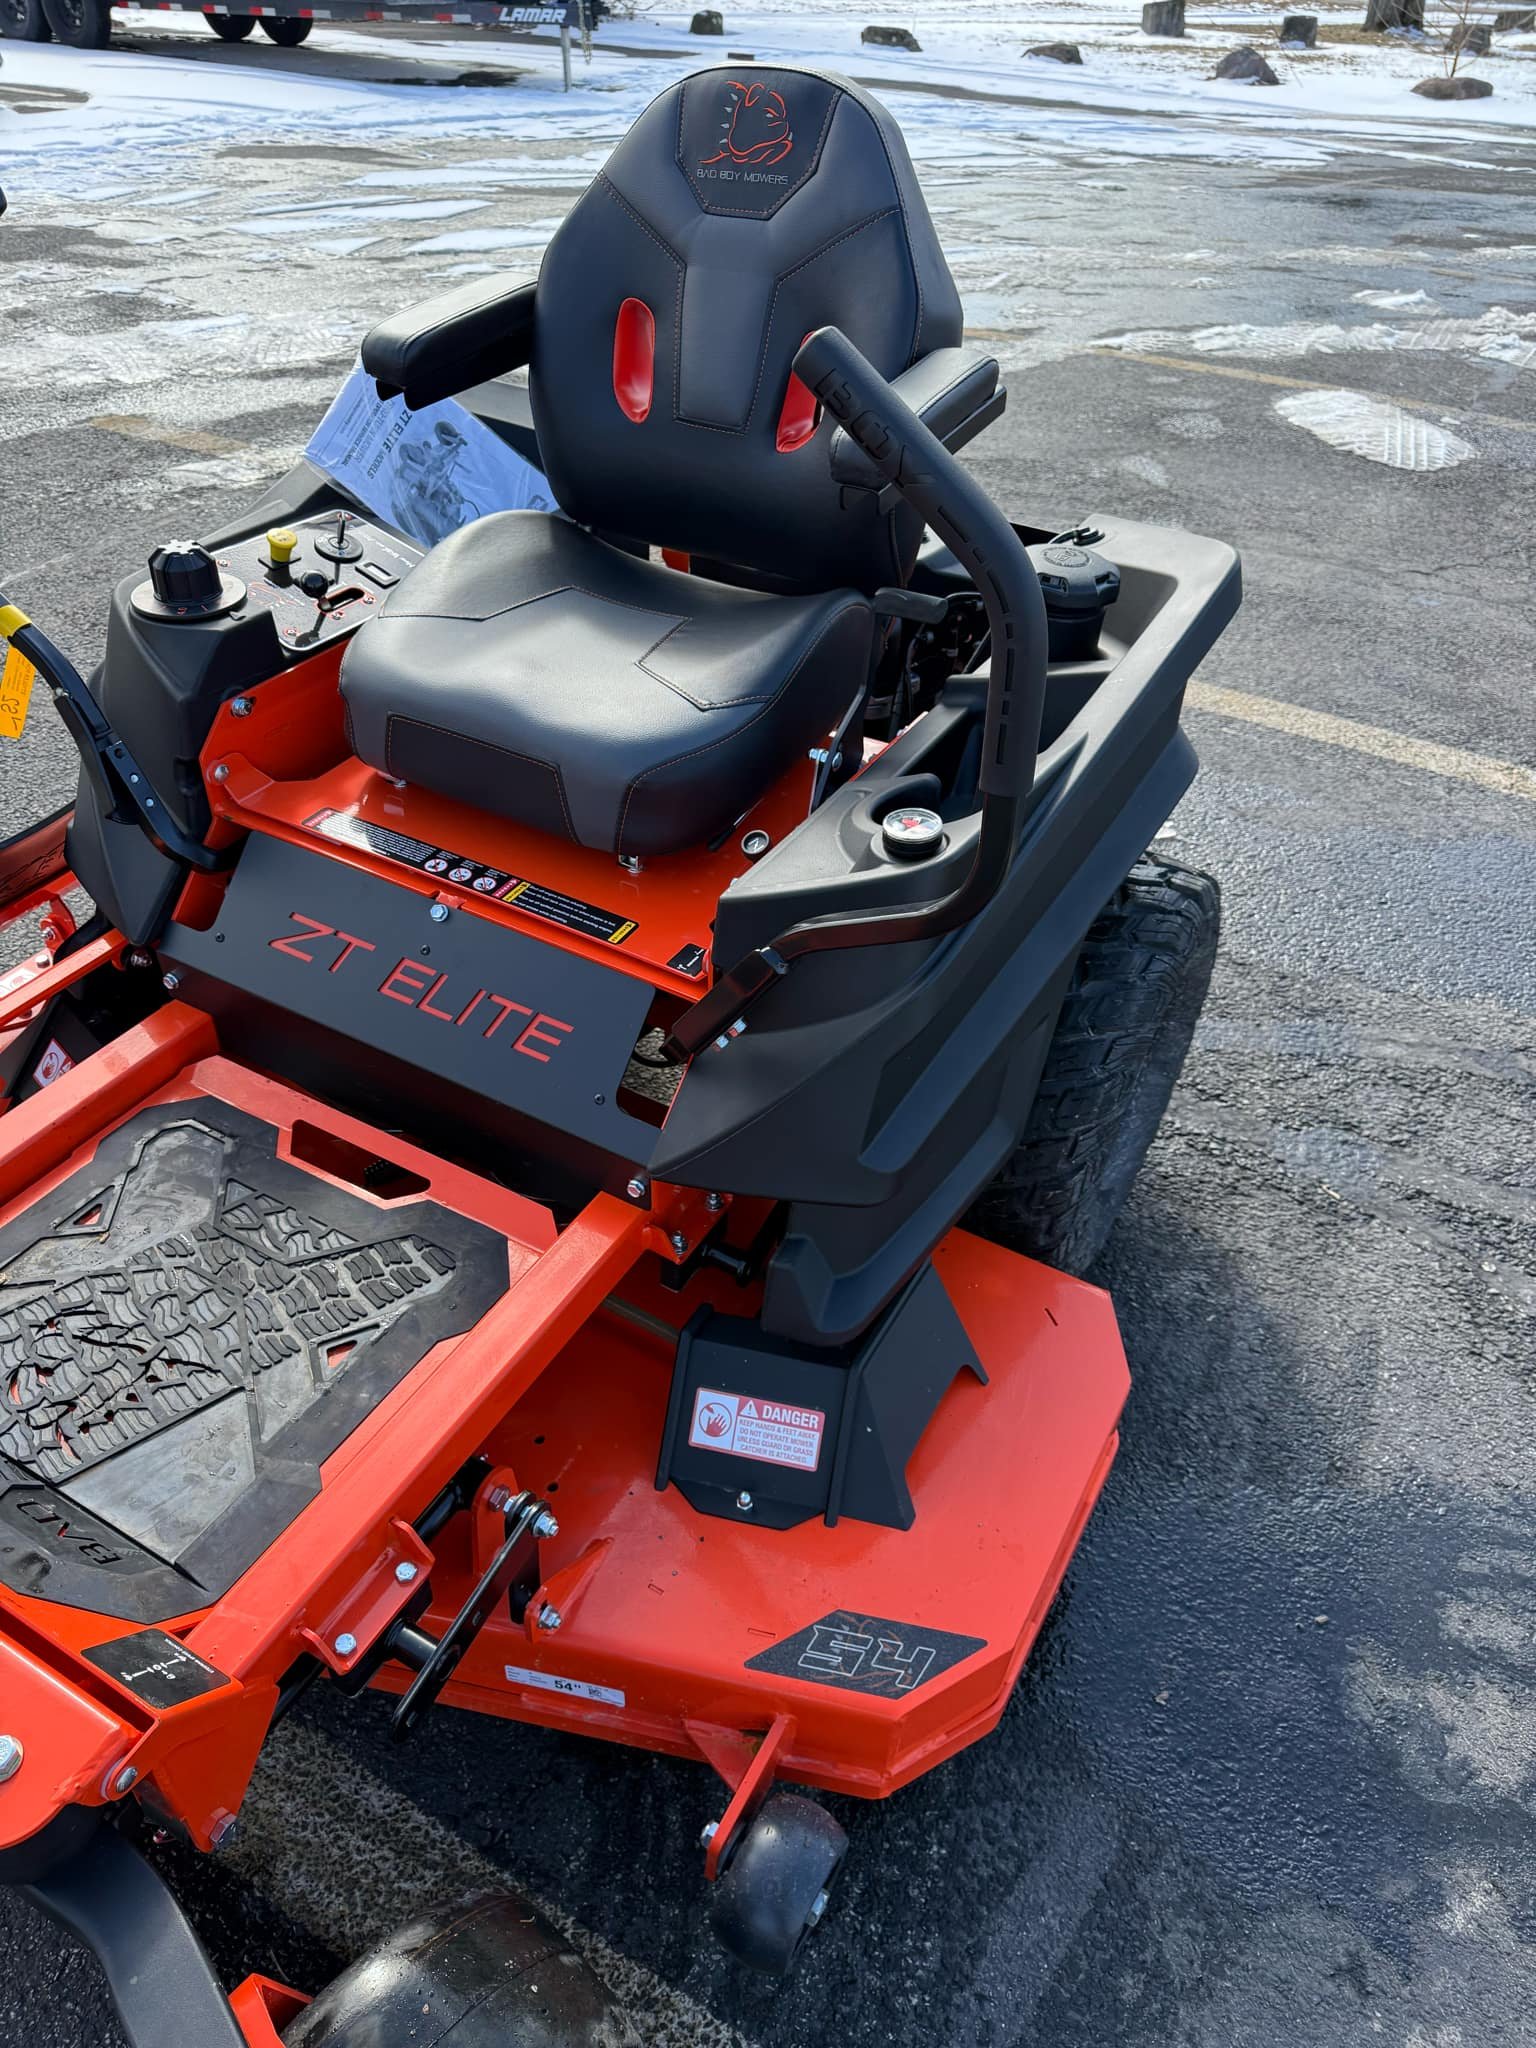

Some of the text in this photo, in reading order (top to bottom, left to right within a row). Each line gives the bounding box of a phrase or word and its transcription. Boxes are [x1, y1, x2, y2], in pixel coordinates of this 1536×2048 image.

[499, 7, 567, 22] LAMAR
[697, 168, 789, 185] BAD BOY MOWERS
[268, 911, 575, 1063] ZT ELITE
[762, 1405, 819, 1429] DANGER
[750, 1429, 761, 1437] NOT
[798, 1625, 937, 1689] 54
[554, 1679, 582, 1692] 54"
